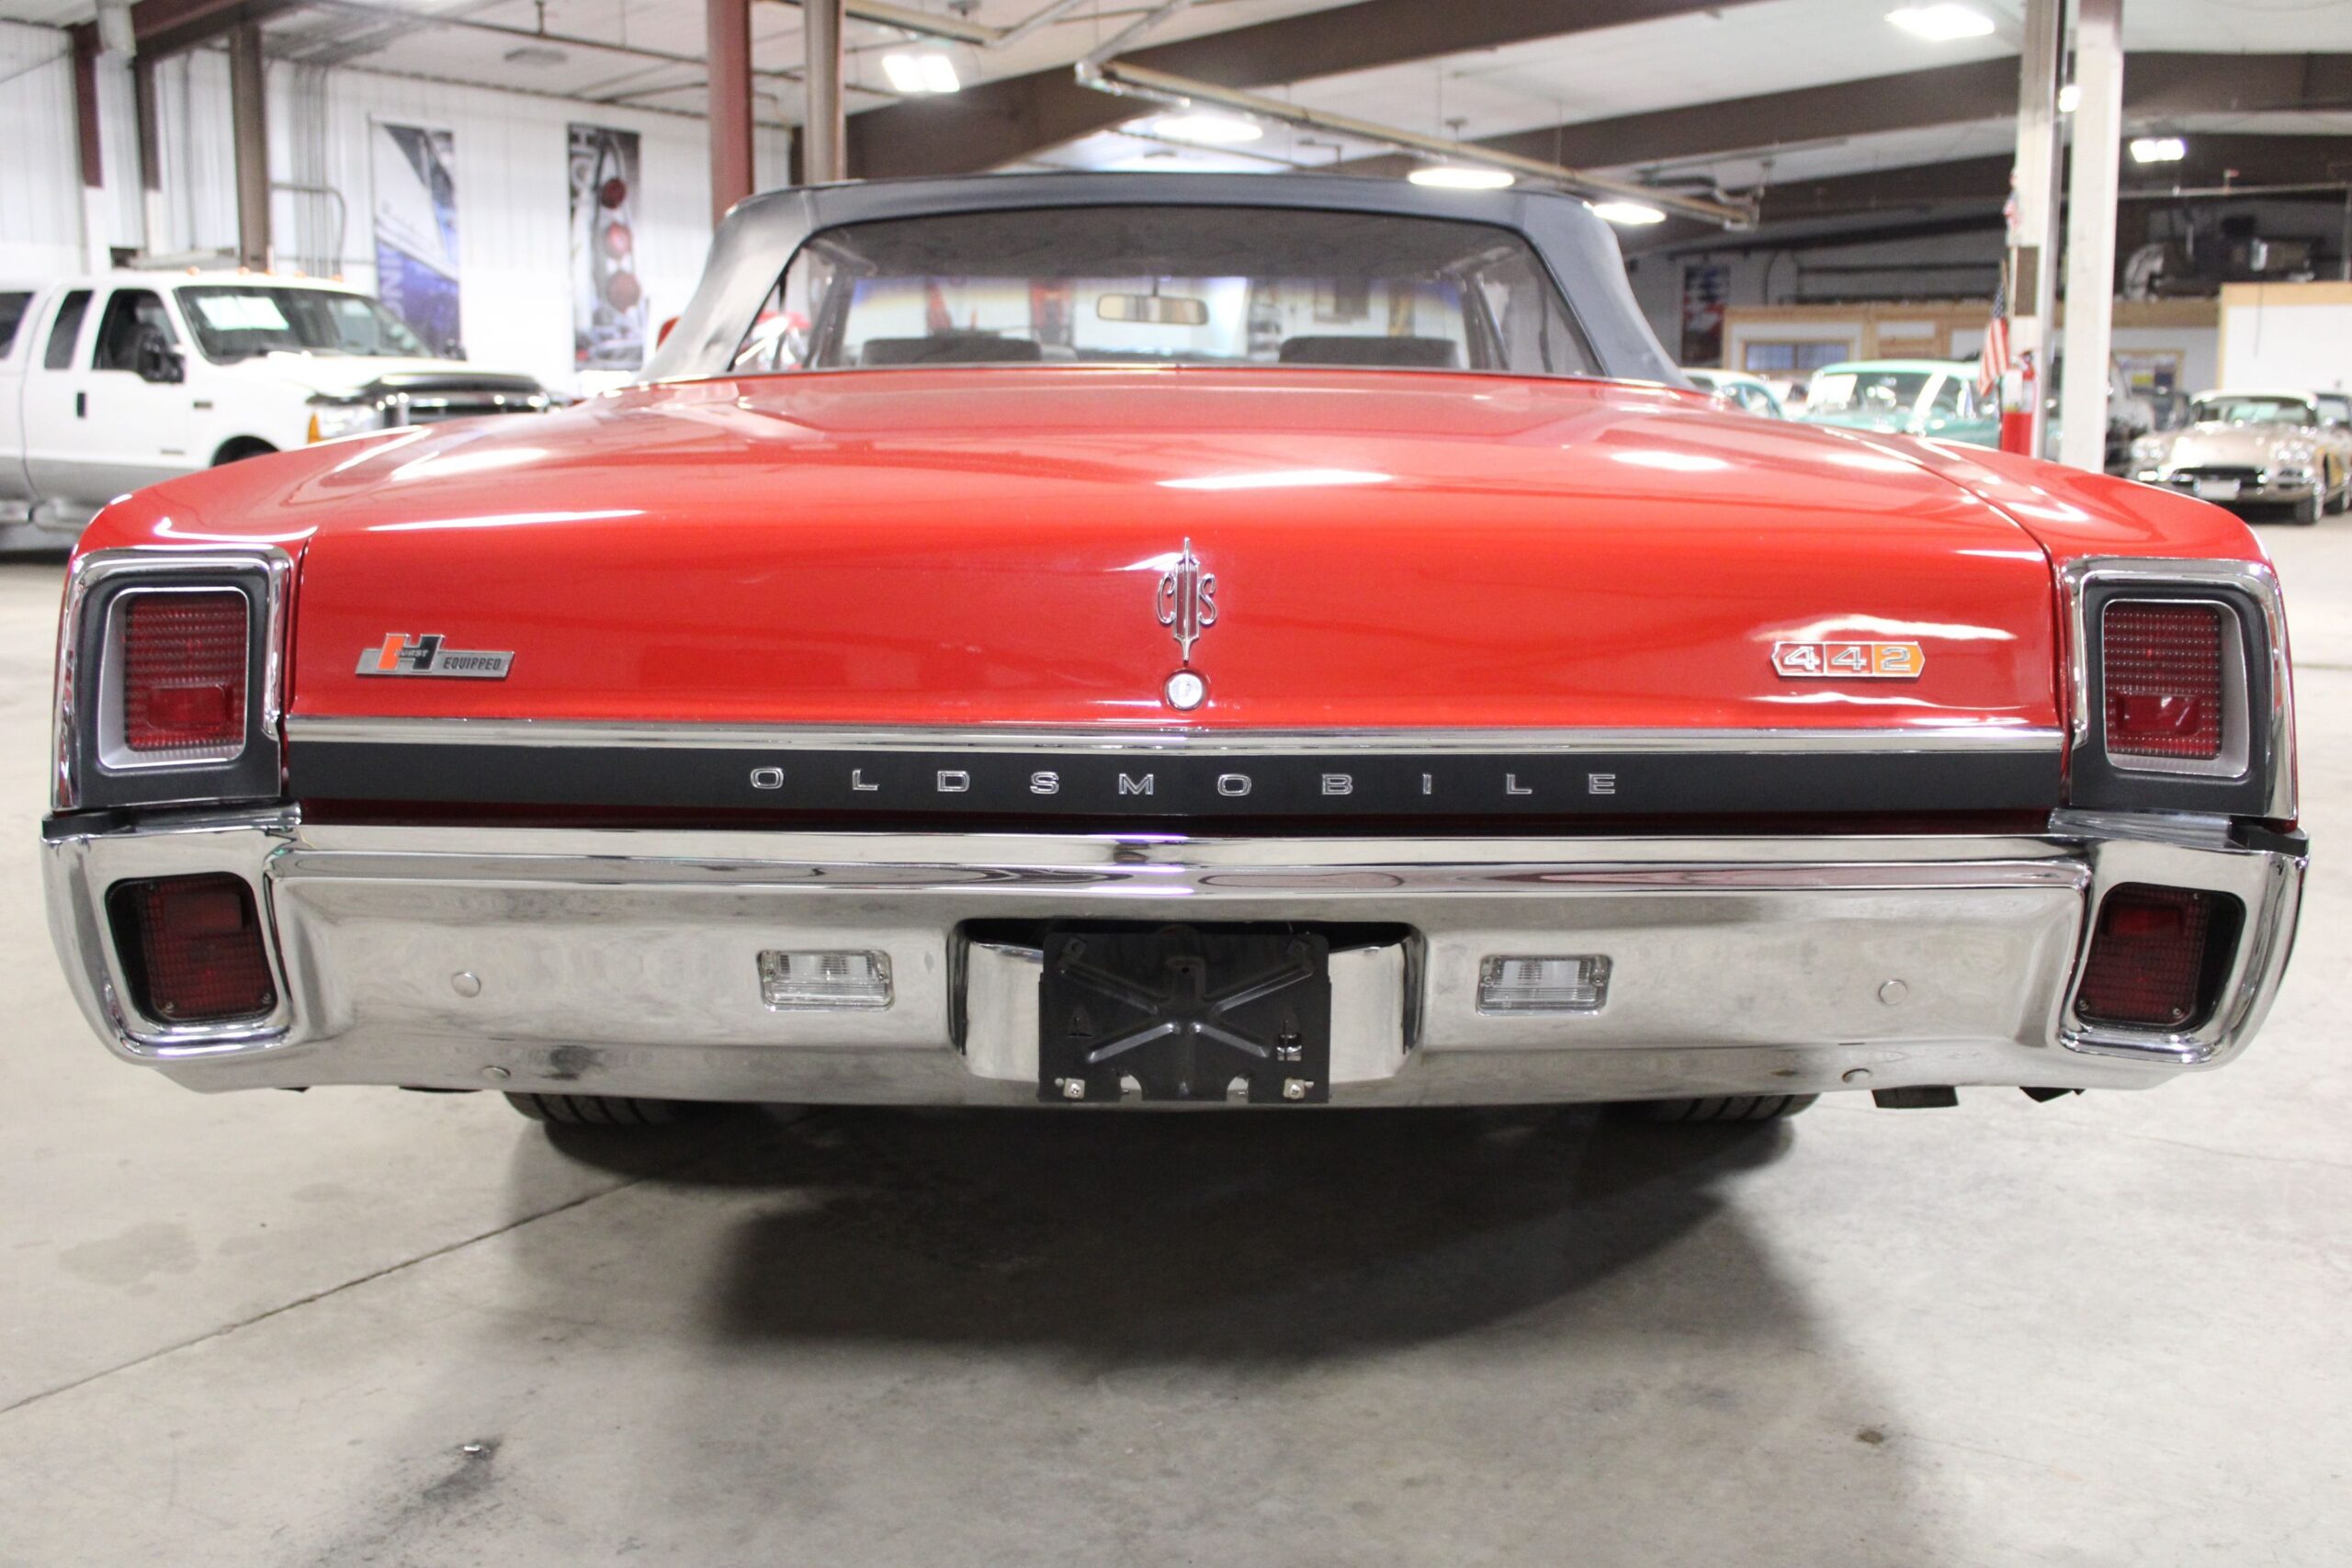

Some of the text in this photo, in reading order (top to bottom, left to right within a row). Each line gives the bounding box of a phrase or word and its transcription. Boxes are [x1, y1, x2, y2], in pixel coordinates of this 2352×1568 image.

[443, 657, 502, 671] EQUIPPED
[1782, 645, 1913, 672] 442
[750, 766, 1616, 795] OLDSMOBILE
